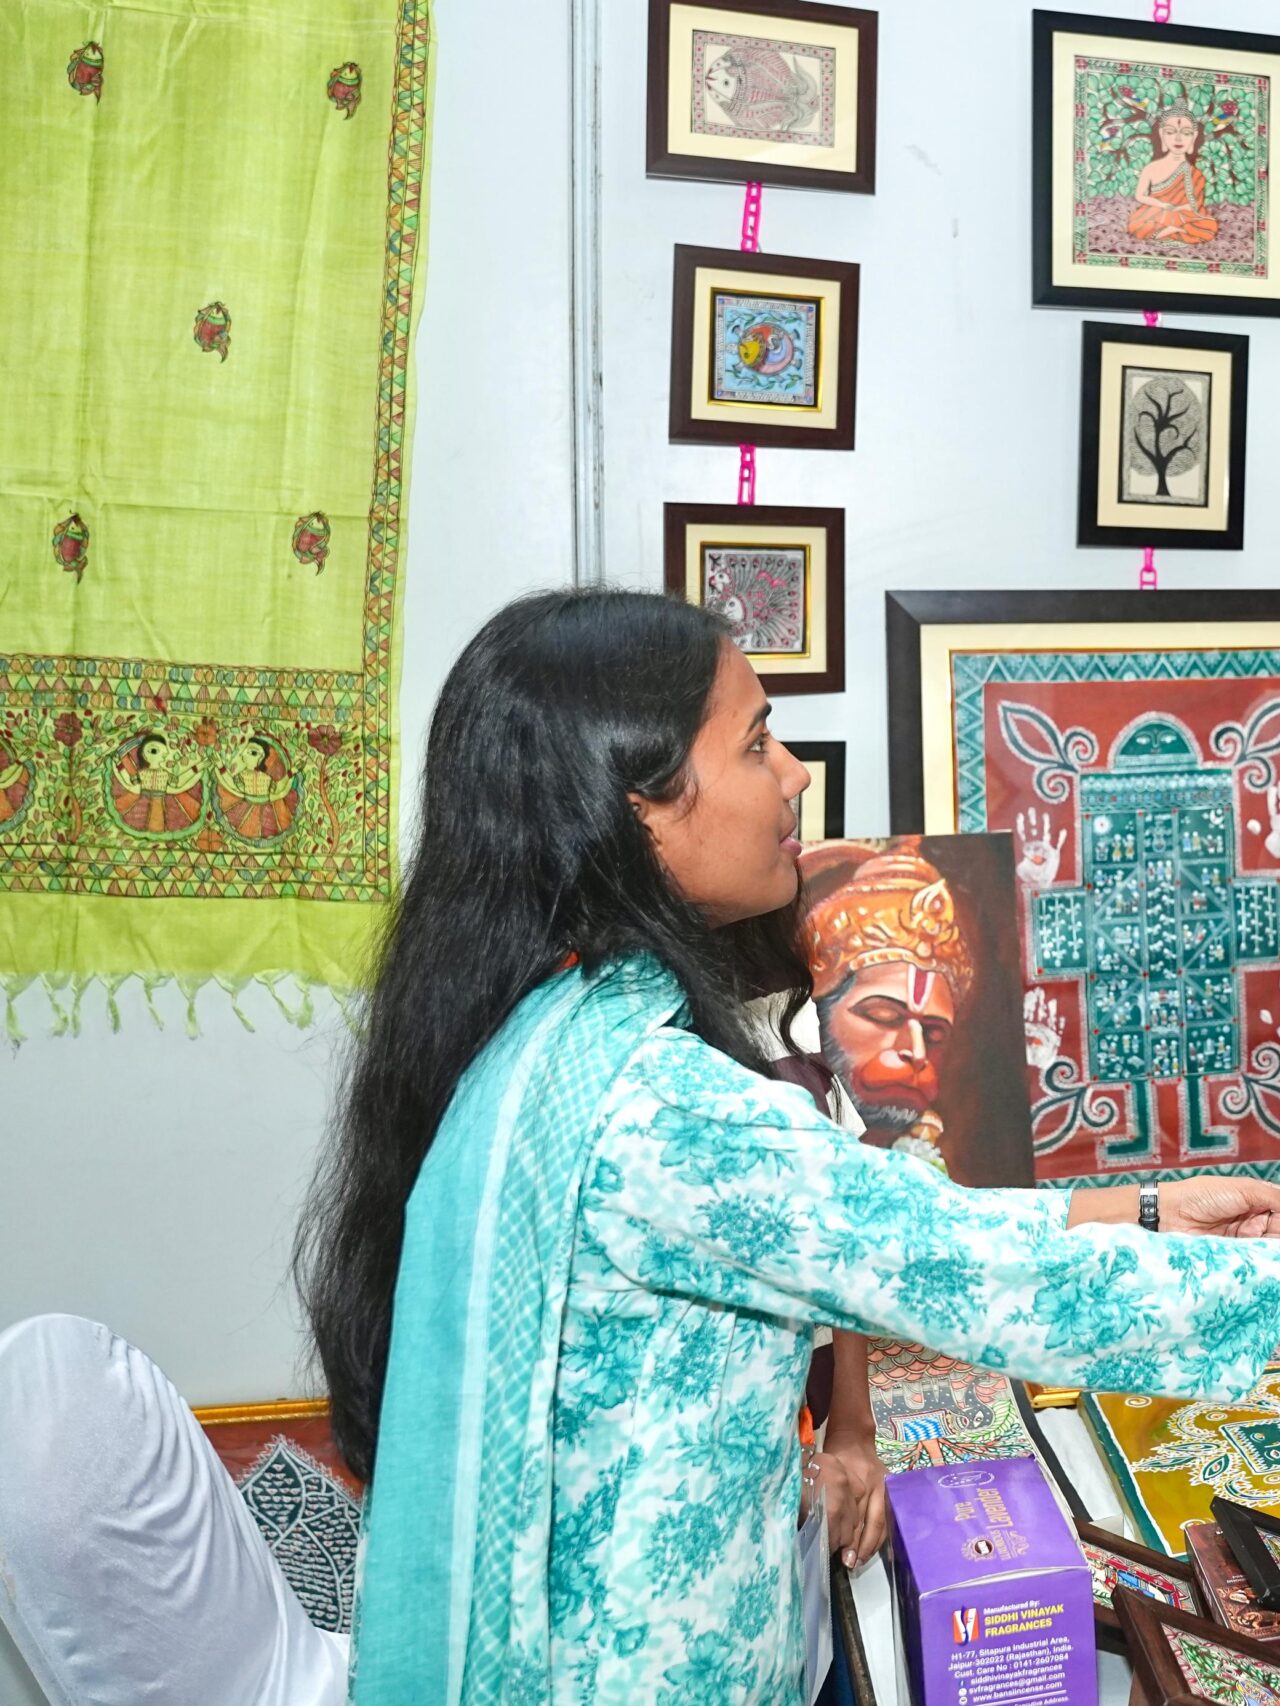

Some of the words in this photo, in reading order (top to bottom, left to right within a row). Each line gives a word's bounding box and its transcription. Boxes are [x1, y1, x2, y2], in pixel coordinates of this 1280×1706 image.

[954, 1501, 977, 1522] Pure
[975, 1488, 1014, 1529] Lavender
[983, 1602, 1028, 1614] Manufactured
[984, 1611, 1019, 1626] SIDDHI
[1020, 1604, 1064, 1618] VINAYAK
[985, 1618, 1052, 1637] FRAGRANCES
[951, 1650, 978, 1661] H1-77,
[979, 1645, 1012, 1657] Sitapura
[1012, 1637, 1049, 1652] Industrial
[1050, 1636, 1071, 1645] Area,
[948, 1654, 1005, 1671] Jaipur-302022
[954, 1669, 976, 1679] Cust.
[976, 1666, 995, 1676] Care
[996, 1664, 1008, 1673] No
[969, 1672, 1066, 1695] svfragrances@gmail.com
[970, 1663, 1063, 1686] siddhivinayakfragrances
